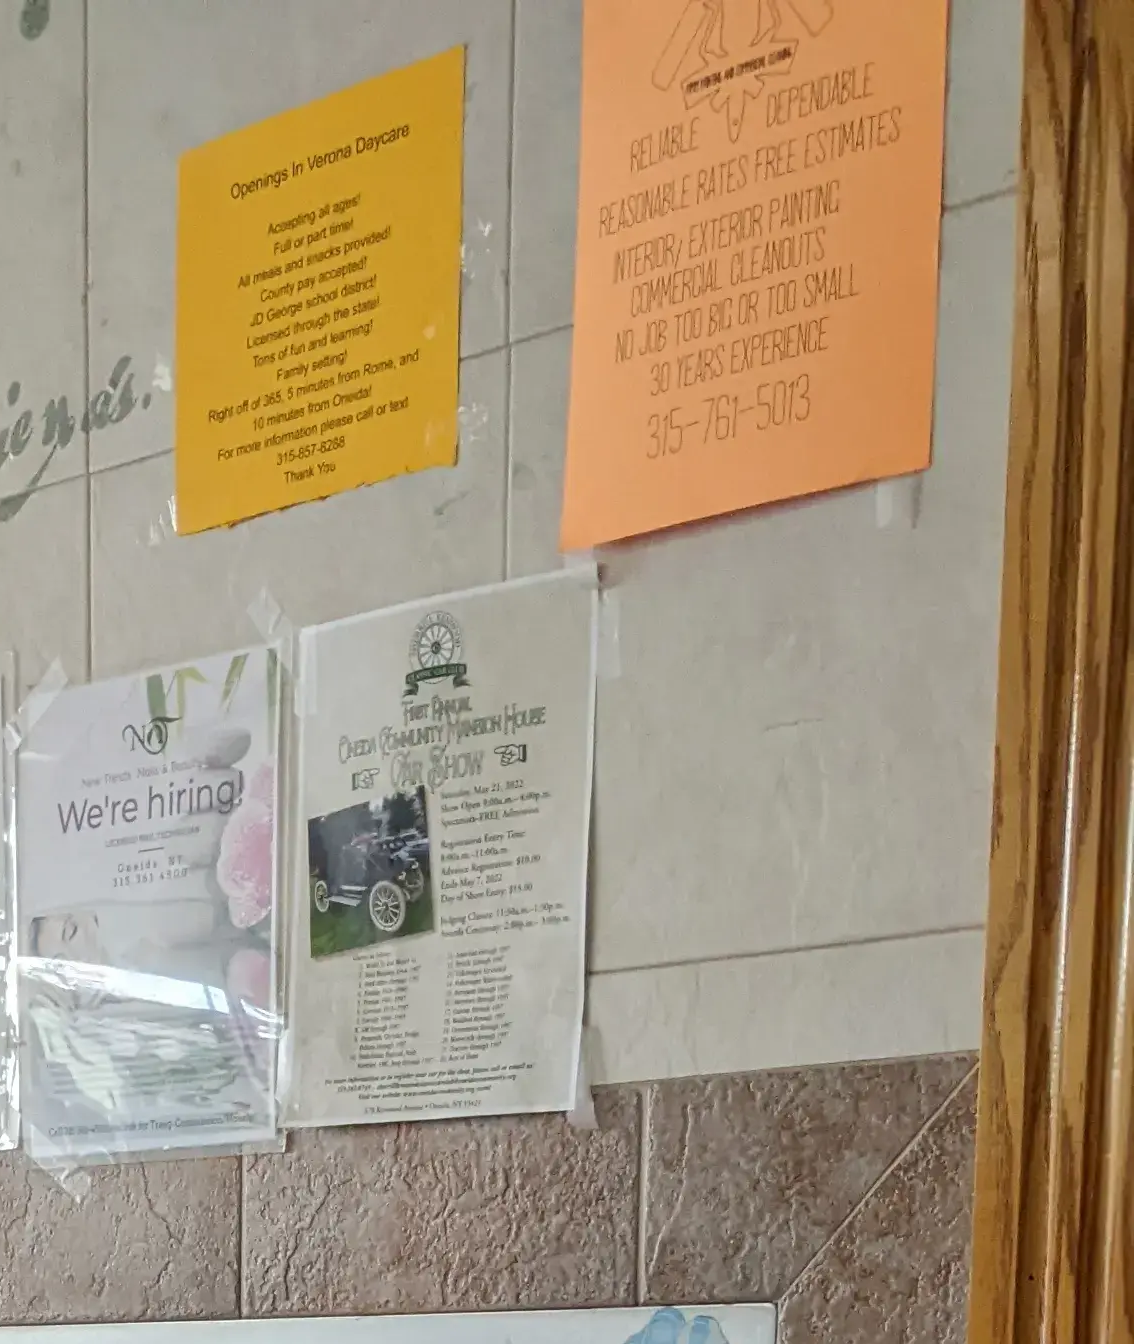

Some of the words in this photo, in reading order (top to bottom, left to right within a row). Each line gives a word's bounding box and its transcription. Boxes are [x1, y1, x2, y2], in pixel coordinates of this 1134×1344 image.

[630, 117, 702, 173] RELIABLE
[766, 62, 876, 129] DEPENDABLE
[231, 167, 288, 199] Openings
[292, 160, 303, 177] In
[308, 144, 352, 171] Verona
[356, 123, 410, 155] Daycare
[598, 174, 691, 239] REASONABLE
[696, 154, 748, 206] RATES
[754, 138, 797, 182] FREE
[803, 106, 902, 169] ESTIMATES
[268, 209, 315, 235] Accepting
[319, 203, 330, 219] all
[274, 241, 292, 255] Full
[294, 236, 305, 249] or
[308, 228, 327, 249] part
[688, 203, 763, 260] EXTERIOR
[769, 179, 840, 235] PAINTING
[238, 275, 251, 288] All
[285, 257, 303, 274] and
[307, 244, 341, 267] snacks
[344, 226, 392, 256] provided!
[260, 282, 295, 303] County
[298, 273, 315, 293] pay
[319, 256, 368, 282] accepted!
[630, 258, 723, 318] COMMERCIAL
[730, 226, 827, 286] CLEANOUTS
[247, 326, 290, 349] Licensed
[294, 315, 331, 337] through
[333, 307, 350, 321] the
[250, 312, 264, 327] JD
[267, 301, 303, 323] George
[306, 286, 339, 308] school
[615, 328, 635, 364] NO
[639, 319, 668, 357] JOB
[674, 307, 702, 347] TOO
[707, 297, 732, 338] BIG
[738, 290, 760, 326] OR
[766, 279, 797, 319] TOO
[803, 264, 861, 309] SMALL
[253, 353, 275, 368] Tons
[278, 347, 288, 361] of
[289, 343, 306, 358] fun
[308, 336, 327, 352] and
[330, 319, 374, 344] learning!
[276, 362, 309, 382] Family
[312, 350, 348, 373] setting!
[650, 361, 670, 397] 30
[676, 344, 725, 390] YEARS
[730, 316, 830, 375] EXPERIENCE
[208, 405, 234, 425] Right
[237, 399, 250, 415] off
[251, 396, 261, 411] of
[287, 386, 294, 401] 5
[296, 377, 335, 398] minutes
[337, 368, 361, 385] from
[363, 359, 397, 377] Rome,
[399, 349, 420, 367] and
[253, 418, 264, 432] 10
[266, 408, 305, 428] minutes
[308, 400, 331, 416] from
[646, 374, 812, 460] 315-761-5013
[218, 446, 235, 462] For
[237, 441, 262, 458] more
[264, 423, 318, 451] information
[320, 413, 354, 437] please
[356, 406, 374, 423] call
[376, 402, 388, 415] or
[284, 466, 315, 485] Thank
[317, 460, 337, 474] You
[57, 794, 139, 835] We're
[148, 770, 246, 820] hiring!
